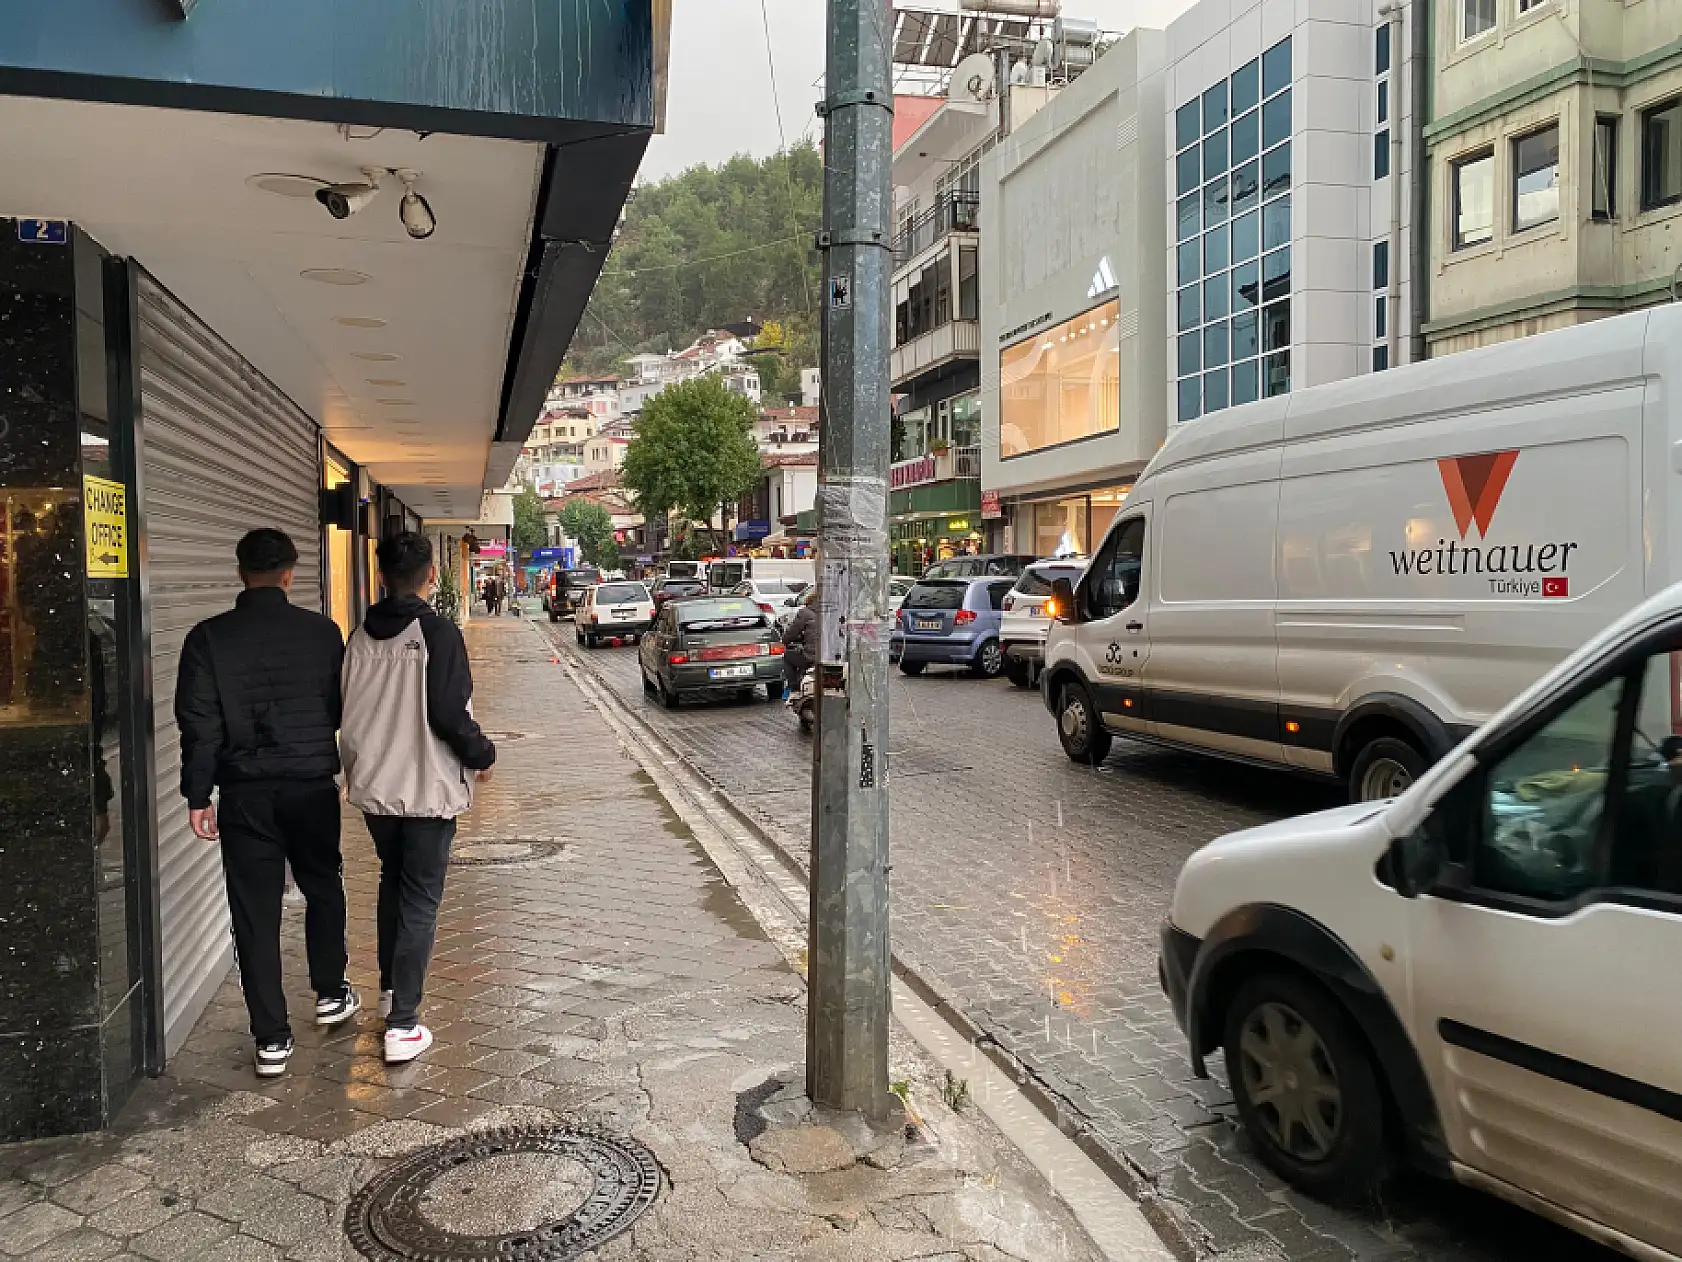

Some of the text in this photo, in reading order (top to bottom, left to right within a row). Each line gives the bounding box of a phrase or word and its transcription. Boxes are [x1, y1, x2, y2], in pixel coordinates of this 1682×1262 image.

[36, 220, 49, 239] 2
[86, 486, 124, 516] CHANGE
[91, 521, 123, 548] OFFICE
[1388, 538, 1578, 576] weitnauer
[1488, 578, 1540, 598] Türkiye
